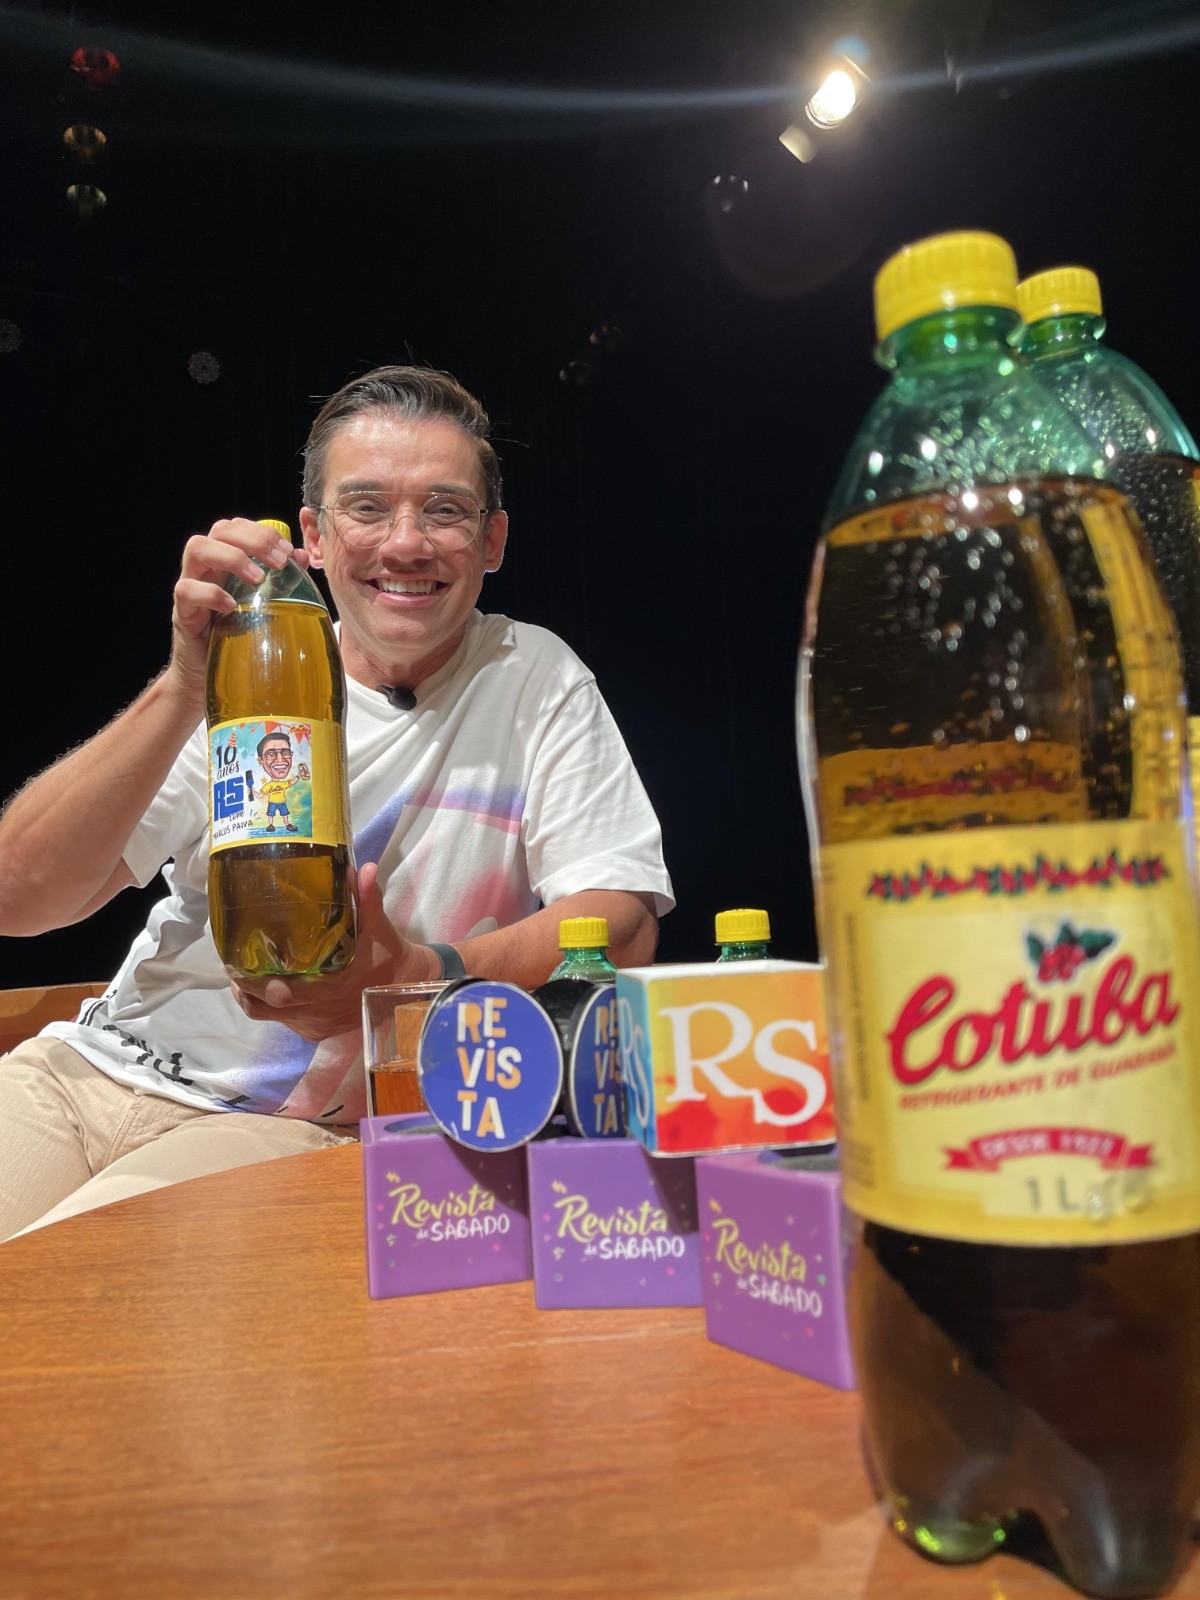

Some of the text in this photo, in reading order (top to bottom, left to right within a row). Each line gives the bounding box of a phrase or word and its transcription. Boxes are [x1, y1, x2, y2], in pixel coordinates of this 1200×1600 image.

[216, 746, 236, 770] 10
[217, 760, 240, 780] anos
[232, 819, 253, 832] PAIVA
[457, 997, 507, 1043] RE
[885, 955, 1181, 1086] Cotuba
[658, 1001, 826, 1127] RS
[457, 1090, 506, 1139] TA
[594, 1092, 618, 1136] TA
[388, 1183, 495, 1228] Revista
[1025, 1175, 1041, 1212] 1
[416, 1229, 429, 1240] de
[554, 1195, 668, 1243] Revista
[584, 1244, 598, 1256] de
[712, 1218, 807, 1284] Revista
